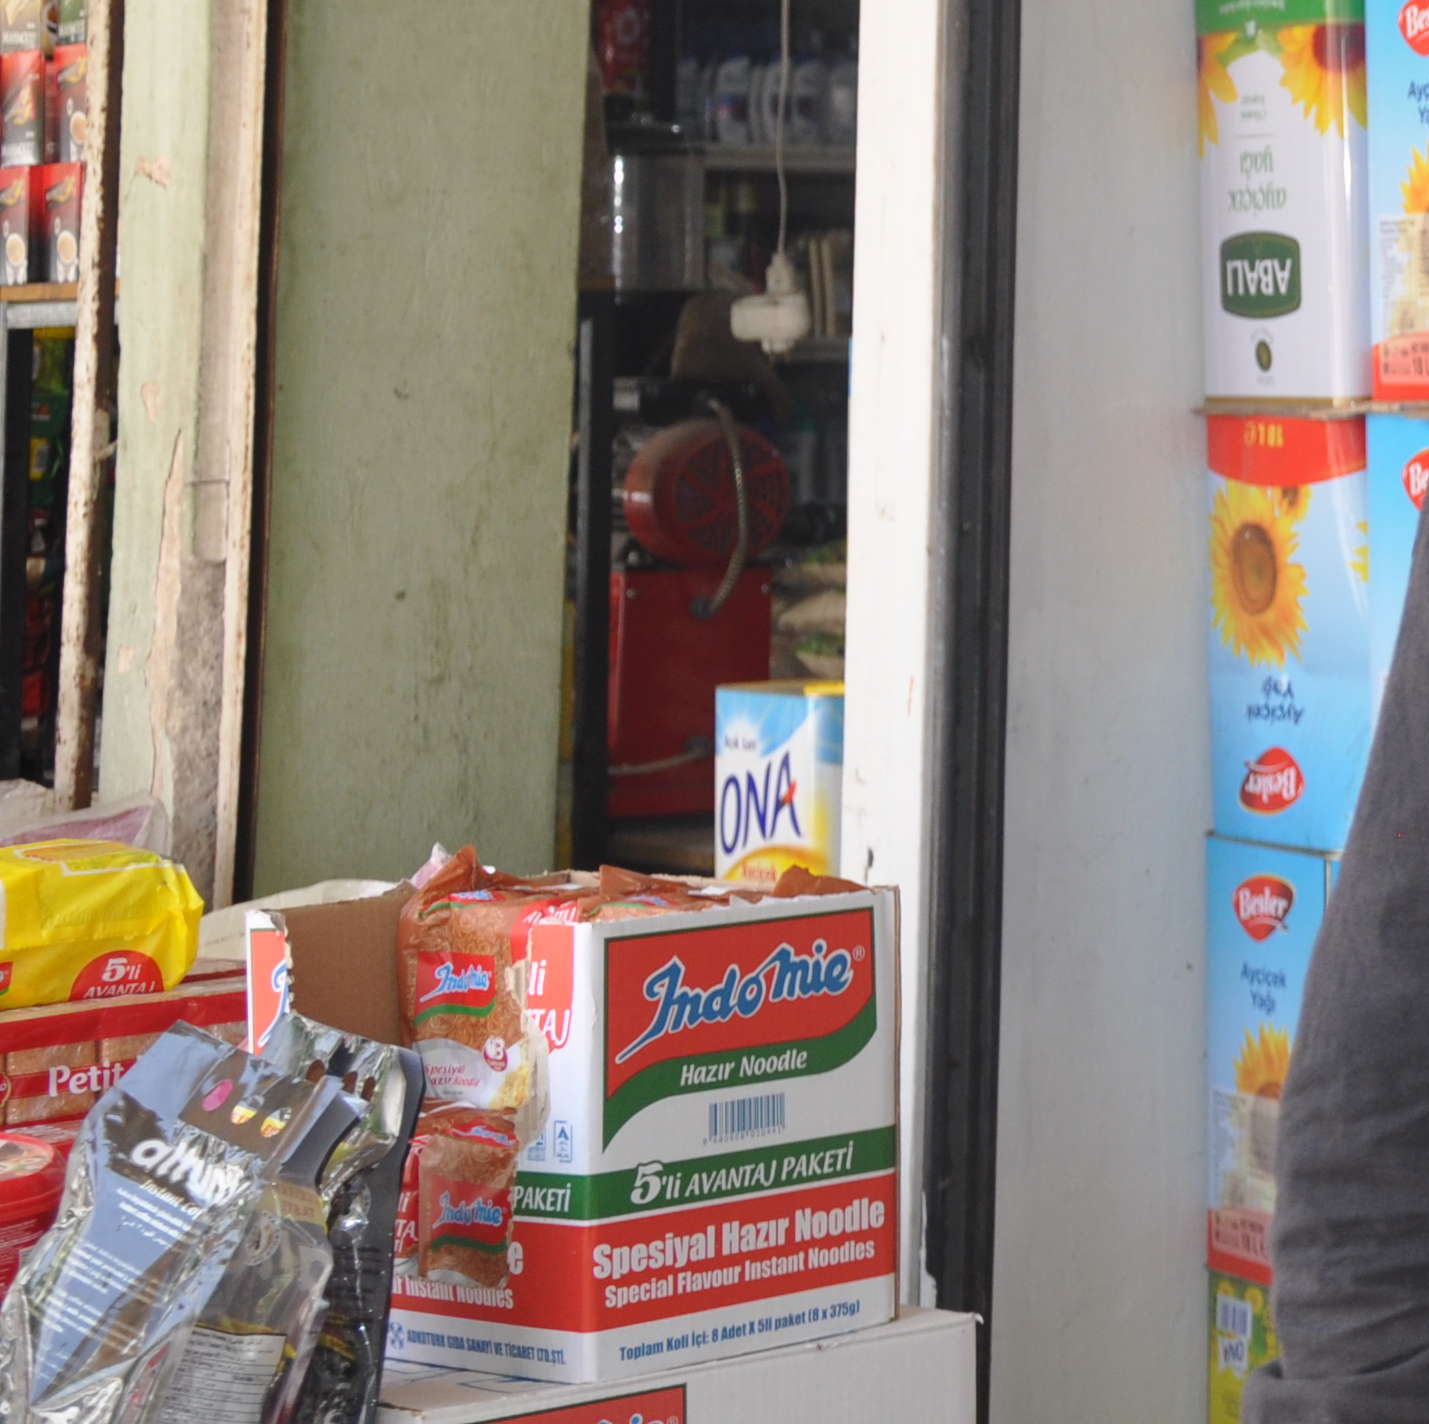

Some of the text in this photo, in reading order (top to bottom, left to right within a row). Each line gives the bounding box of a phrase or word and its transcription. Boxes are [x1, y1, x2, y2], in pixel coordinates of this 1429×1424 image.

[1225, 258, 1292, 297] ABALI
[1247, 702, 1304, 725] Ayçiçek
[720, 751, 802, 854] ONA
[1245, 767, 1297, 804] Besler
[1238, 885, 1289, 920] Besler
[102, 957, 141, 983] 5'li
[1240, 960, 1287, 990] Ayçiçek
[615, 938, 853, 1064] Indomie
[48, 1062, 124, 1098] Petit
[425, 1063, 466, 1079] Spesiyal
[430, 1077, 453, 1087] azır
[680, 1049, 808, 1087] Hazır Noodle
[630, 1140, 854, 1205] 5'li AVANTAJ PAKETİ
[140, 1179, 184, 1210] Instant
[514, 1183, 572, 1212] PAKETİ
[592, 1197, 886, 1280] Spesiyal Hazır Noodle
[604, 1239, 876, 1309] Special Flavour Instant Noodles
[447, 1335, 465, 1350] GIDA
[466, 1337, 492, 1354] SANAYİ
[494, 1342, 503, 1356] VE
[504, 1341, 535, 1359] TİCARET
[620, 1342, 664, 1361] Toplam
[666, 1337, 689, 1353] Koli
[711, 1329, 720, 1343] 8
[721, 1323, 747, 1342] Adet
[774, 1312, 806, 1332] paket
[808, 1307, 819, 1324] (8
[829, 1299, 860, 1317] 375g)
